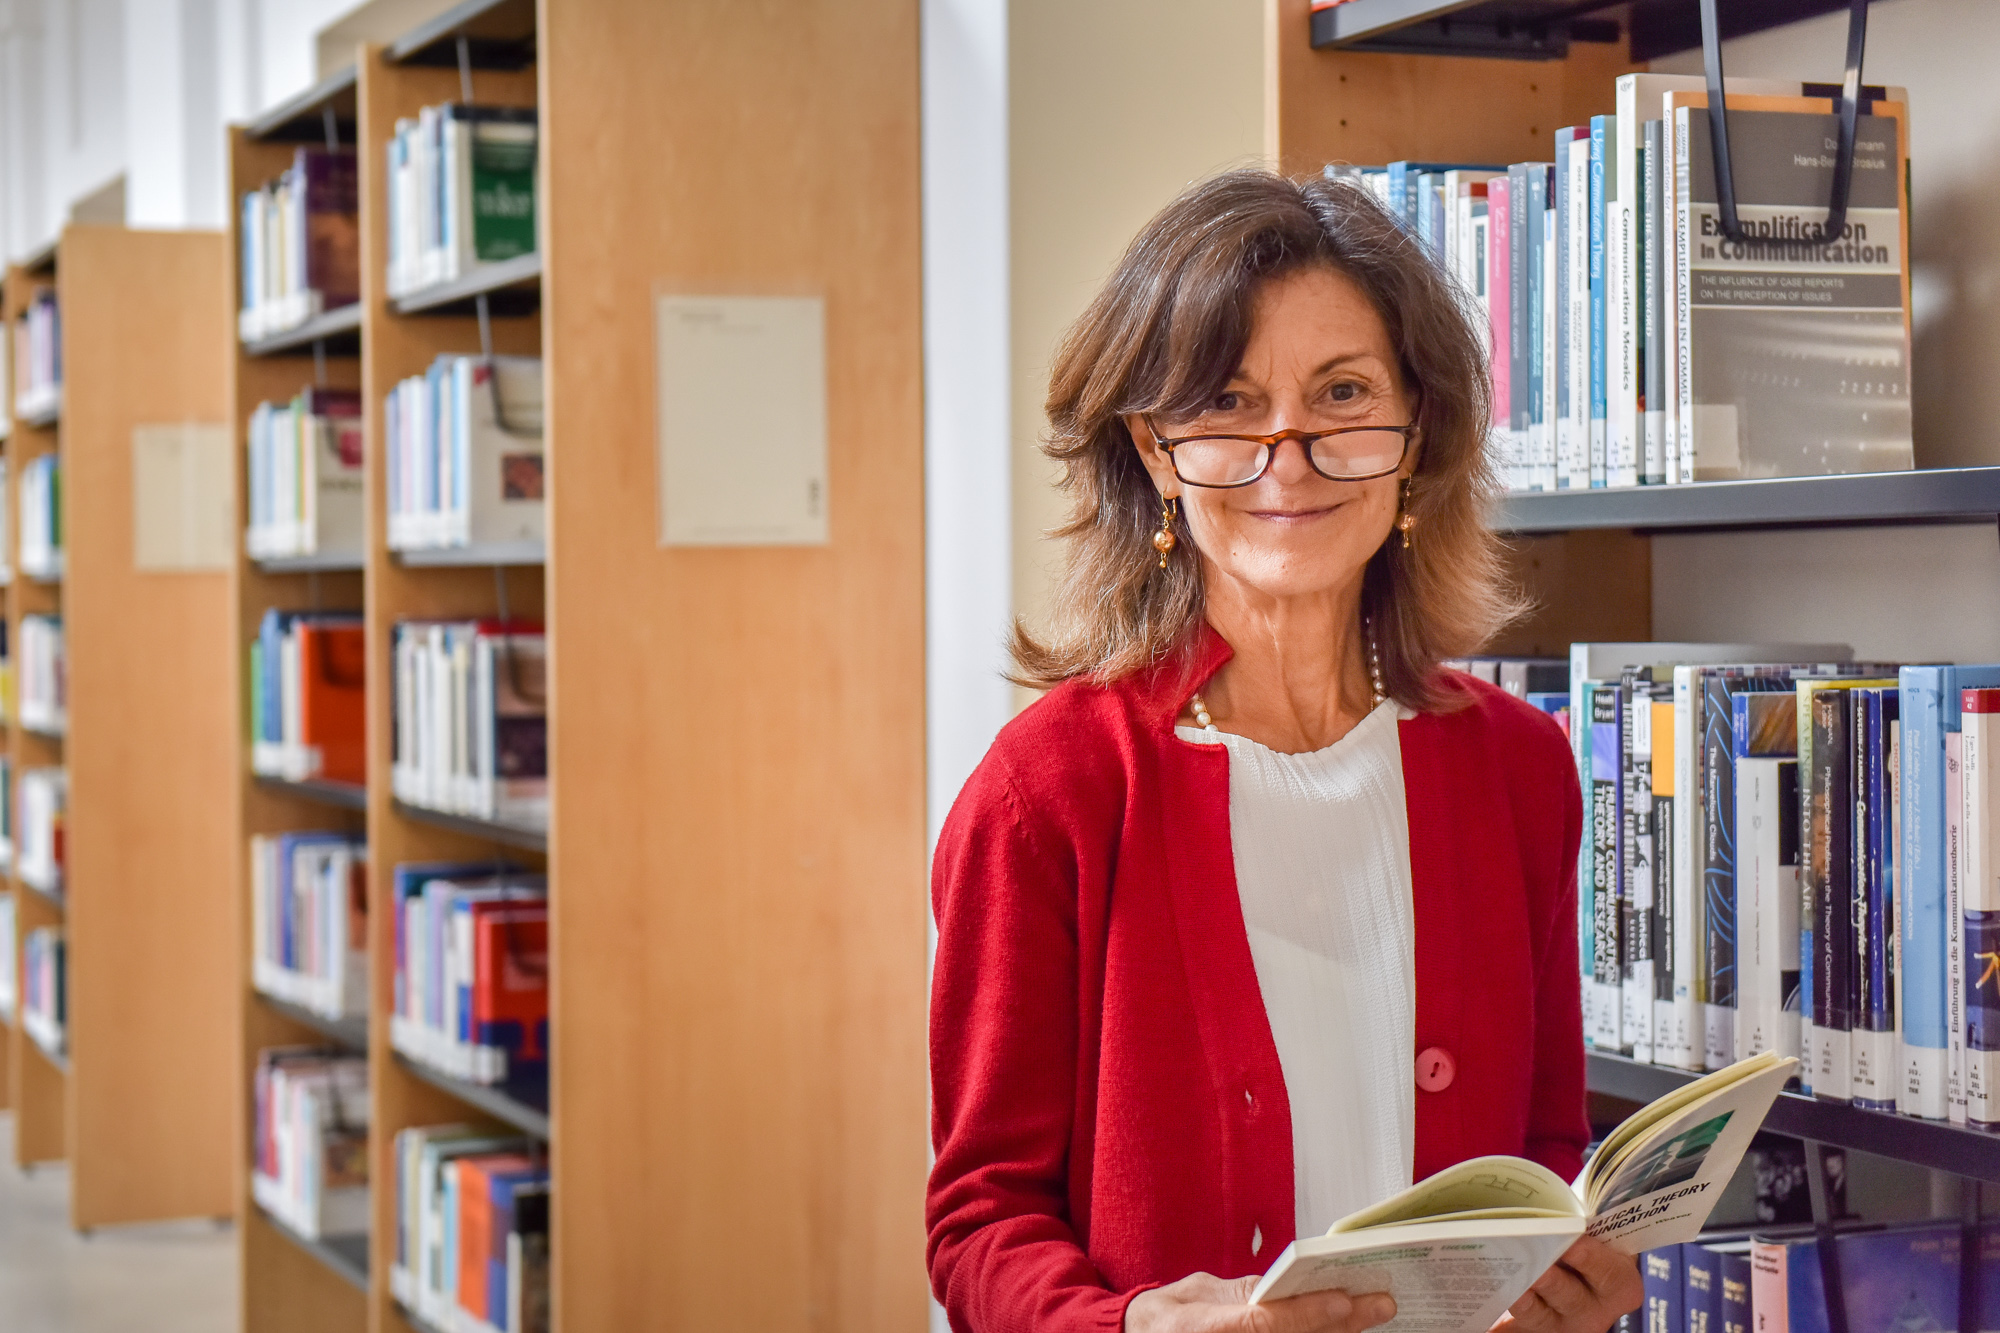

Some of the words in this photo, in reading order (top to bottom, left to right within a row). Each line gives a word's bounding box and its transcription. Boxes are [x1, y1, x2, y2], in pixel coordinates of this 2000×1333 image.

[1591, 128, 1604, 160] Using
[1664, 110, 1673, 192] Communication
[1793, 154, 1837, 167] Hans-Ber
[1591, 162, 1604, 243] Communication
[1664, 195, 1673, 210] for
[1700, 213, 1867, 243] Exmplificaon
[1590, 241, 1604, 279] Theory
[1622, 207, 1631, 325] Communication
[1677, 209, 1688, 323] EXEMPLIFICATION
[1718, 238, 1888, 263] Communication
[1663, 248, 1673, 294] sciences
[1700, 275, 1717, 285] THE
[1718, 276, 1765, 286] INFLUENCE
[1766, 276, 1778, 286] OF
[1779, 277, 1802, 287] CASE
[1804, 277, 1844, 288] REPORTS
[1562, 249, 1570, 344] COMMUNICATION
[1593, 297, 1601, 330] Windahl
[1700, 290, 1713, 299] ON
[1715, 290, 1732, 300] THE
[1733, 290, 1786, 301] PERCEPTION
[1788, 291, 1800, 301] OF
[1801, 291, 1832, 302] ISSUES
[1679, 327, 1688, 341] IN
[1562, 348, 1570, 389] THEORY
[1622, 330, 1631, 392] Mosaics
[1802, 694, 1811, 780] SPEAKING
[1906, 729, 1914, 776] THEORIES
[1913, 729, 1921, 749] Paul
[1708, 746, 1717, 767] The
[1856, 754, 1864, 796] TANKARD
[1912, 750, 1921, 781] Cobley,
[1638, 762, 1648, 833] Theories
[1708, 768, 1717, 822] Marvelous
[1822, 766, 1832, 834] Philosophical
[1906, 777, 1914, 799] AND
[1913, 782, 1921, 805] Peter
[1594, 785, 1606, 850] THEORY
[1606, 785, 1617, 846] HUMAN
[1802, 788, 1812, 832] INTO
[1906, 801, 1914, 841] MODELS
[1913, 814, 1921, 843] Schulz
[1638, 838, 1648, 855] of
[1708, 824, 1717, 861] Clouds
[1802, 840, 1812, 874] THE
[1822, 835, 1832, 872] Profiles
[1856, 800, 1867, 897] Communication
[1906, 843, 1914, 855] OF
[1594, 851, 1606, 888] AND
[1824, 873, 1832, 885] in
[1949, 824, 1960, 943] Kommunikationstheorie
[1802, 880, 1812, 911] AIR
[1824, 885, 1832, 902] the
[1906, 857, 1914, 940] COMMUNICATION
[1594, 891, 1607, 977] RESEARCH
[1605, 849, 1618, 984] COMMUNICATION
[1822, 904, 1832, 940] Theory
[1857, 901, 1868, 957] Theories
[1824, 941, 1832, 954] of
[1951, 946, 1960, 962] die
[1951, 965, 1960, 976] in
[1824, 954, 1833, 1030] Communicatio
[1951, 977, 1960, 1034] Einführung
[1651, 1182, 1711, 1207] THEORY
